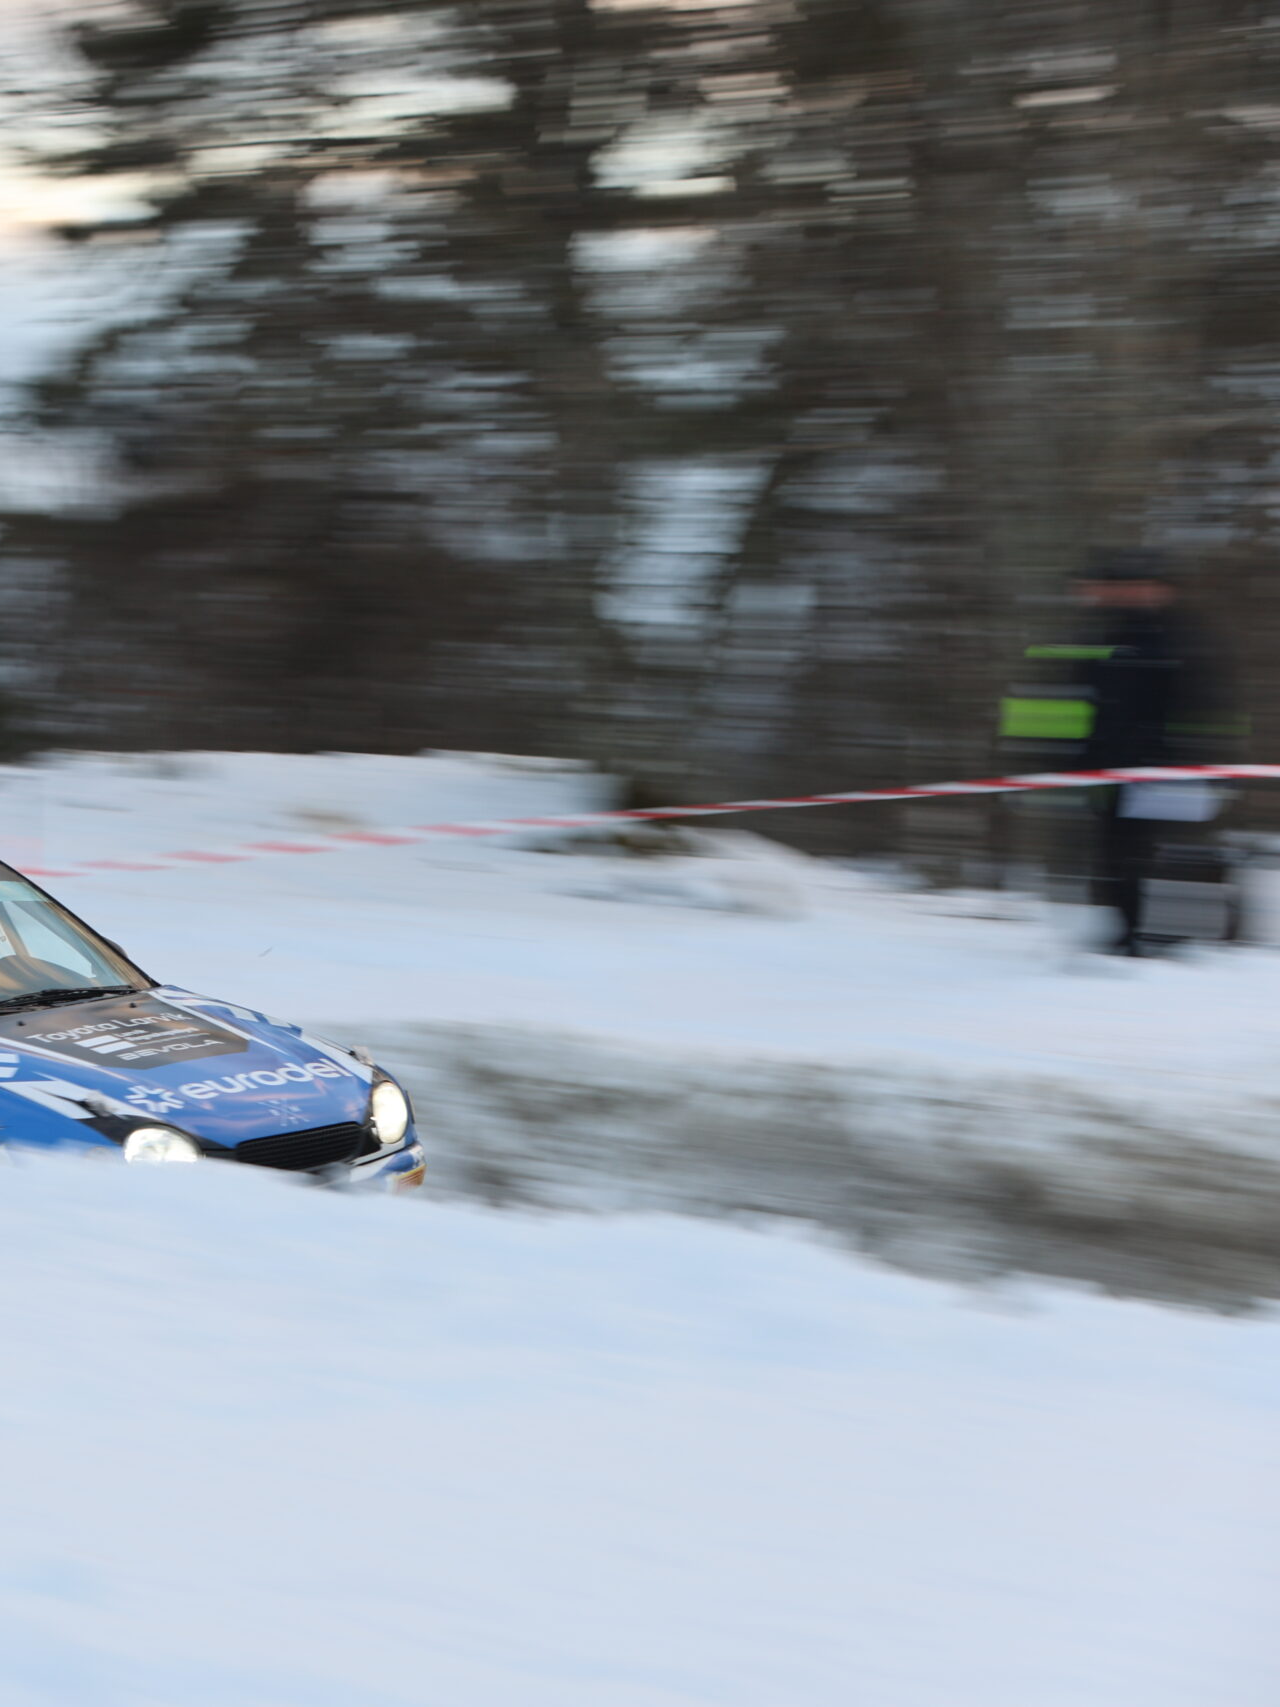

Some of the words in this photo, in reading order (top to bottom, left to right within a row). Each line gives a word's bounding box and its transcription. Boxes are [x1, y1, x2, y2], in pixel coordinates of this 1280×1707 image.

[26, 1018, 121, 1043] Toyota
[120, 1013, 193, 1028] Larvik
[117, 1038, 225, 1061] BEVOLA
[178, 1058, 352, 1099] eurodel
